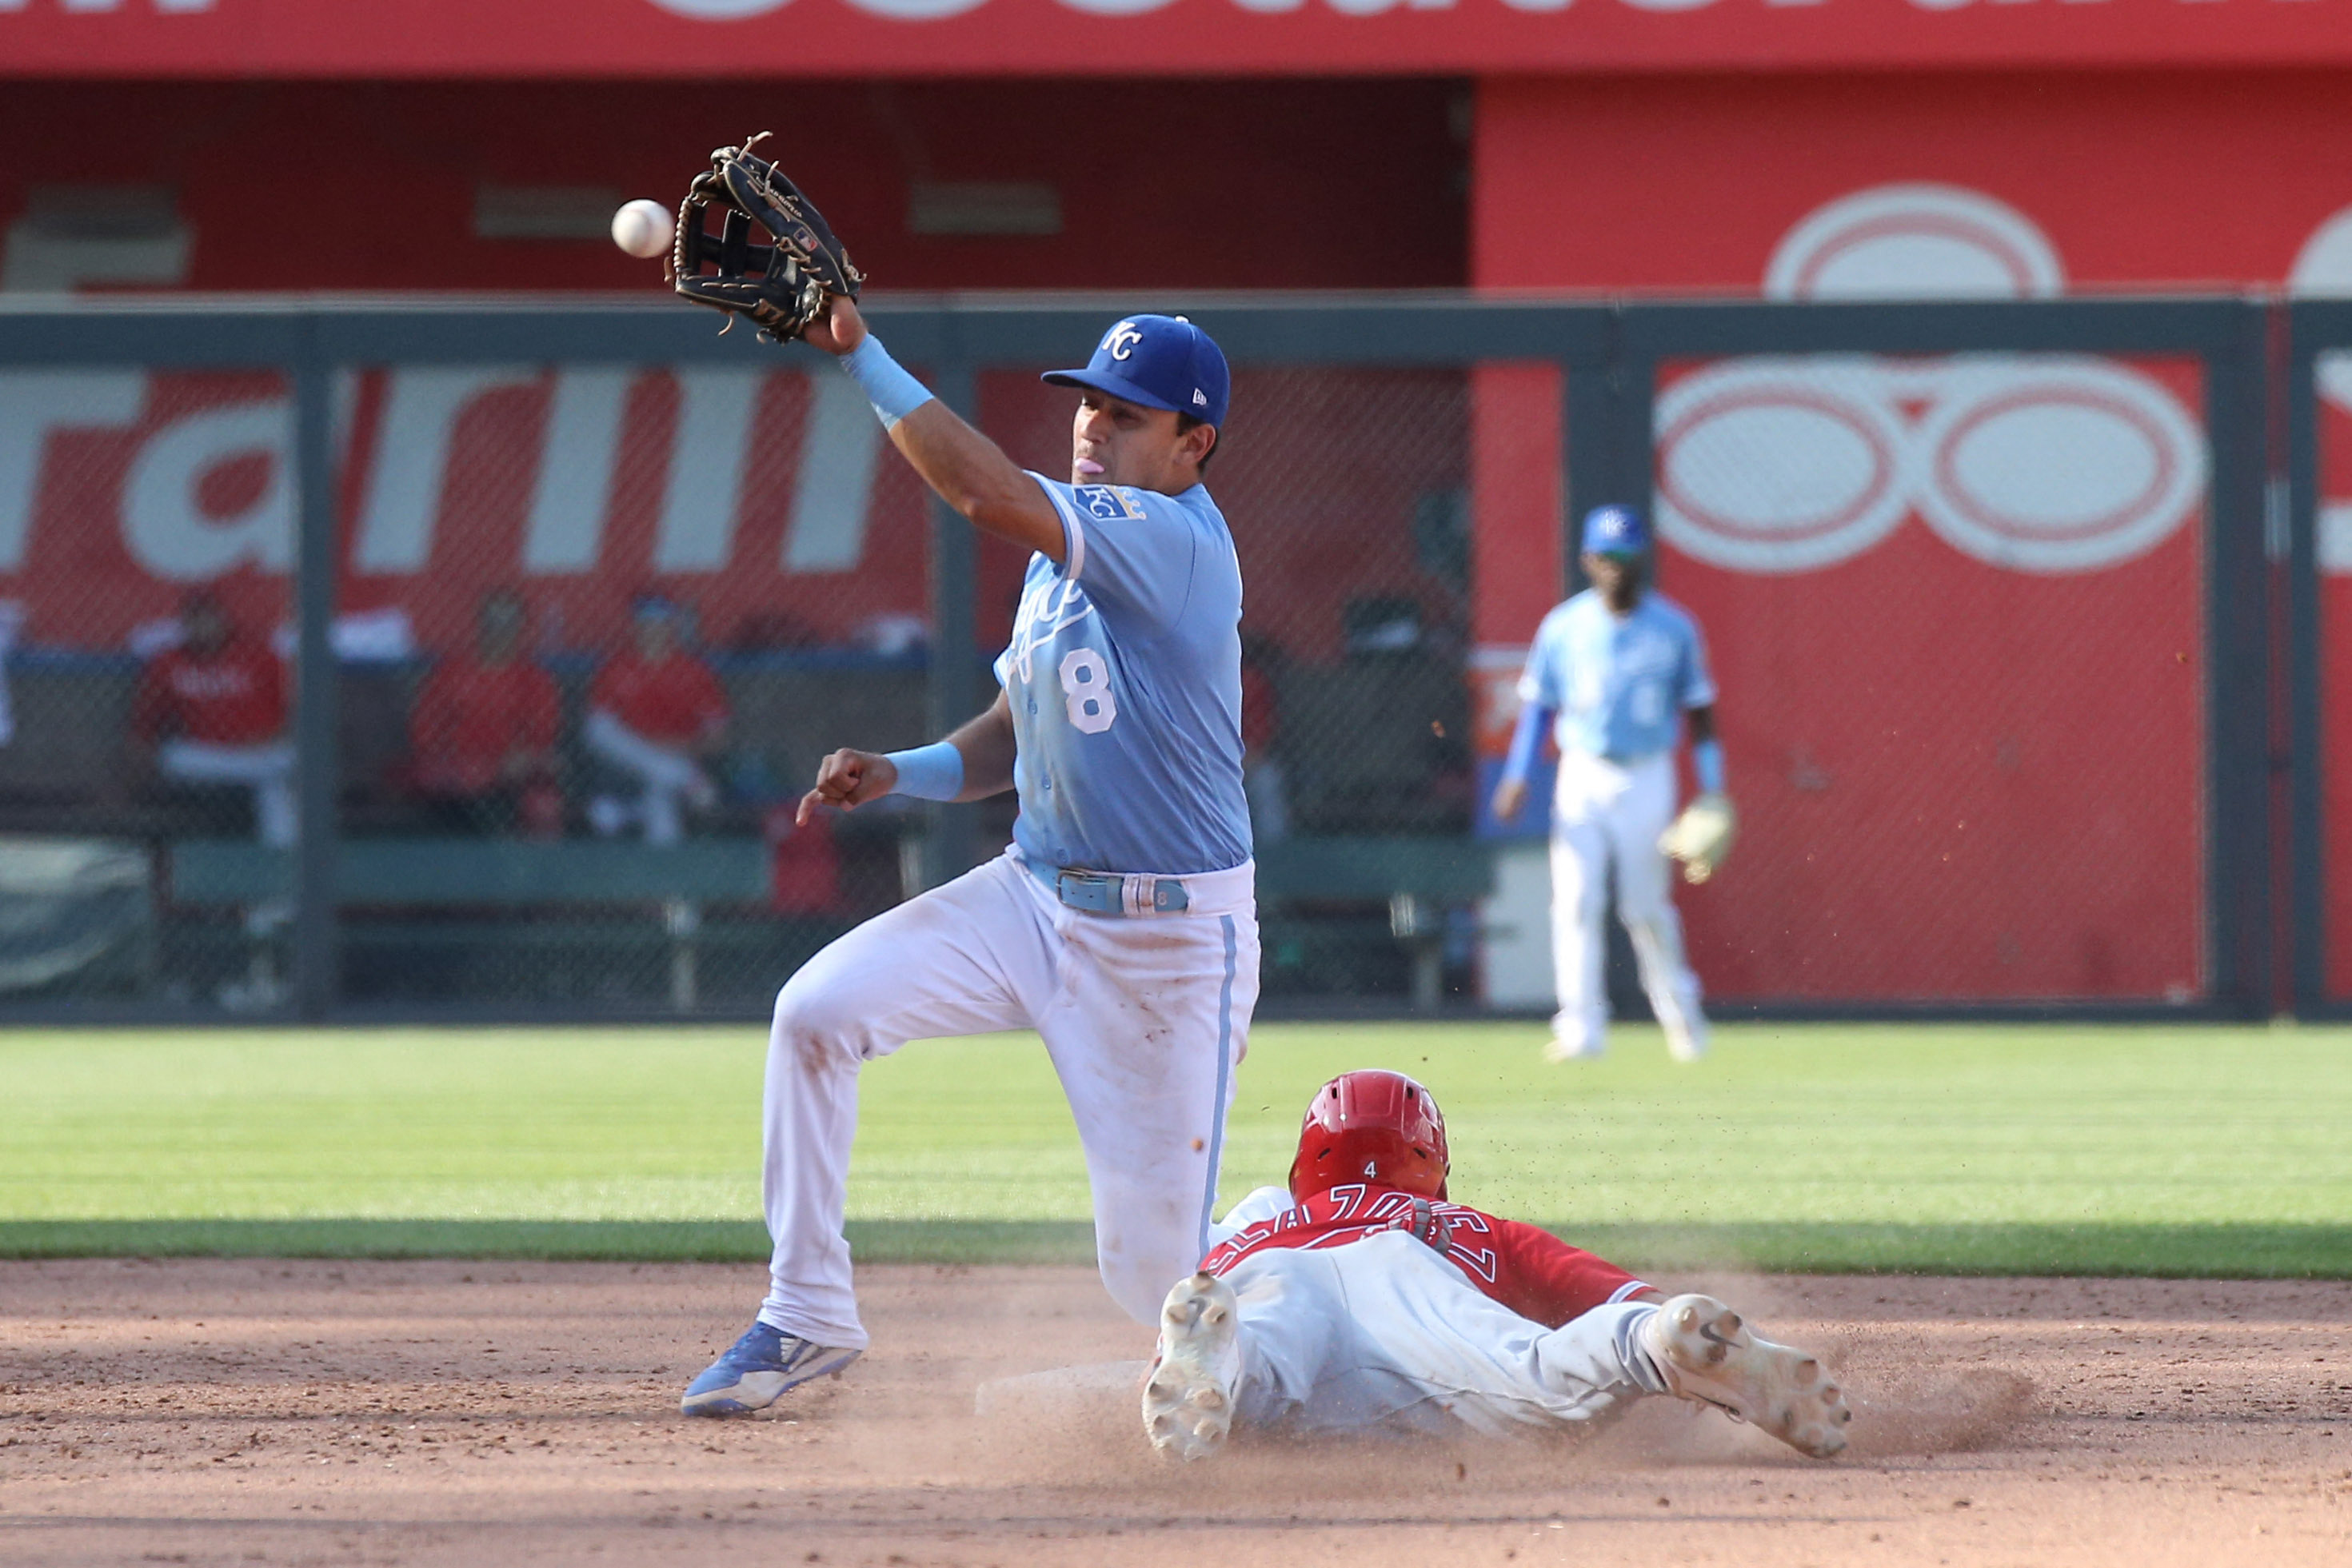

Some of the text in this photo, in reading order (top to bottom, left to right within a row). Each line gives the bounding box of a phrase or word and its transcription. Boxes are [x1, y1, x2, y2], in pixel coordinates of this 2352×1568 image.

[1101, 321, 1143, 361] KC
[1081, 486, 1116, 517] KC
[1059, 648, 1117, 734] 8
[1364, 1160, 1377, 1179] 4
